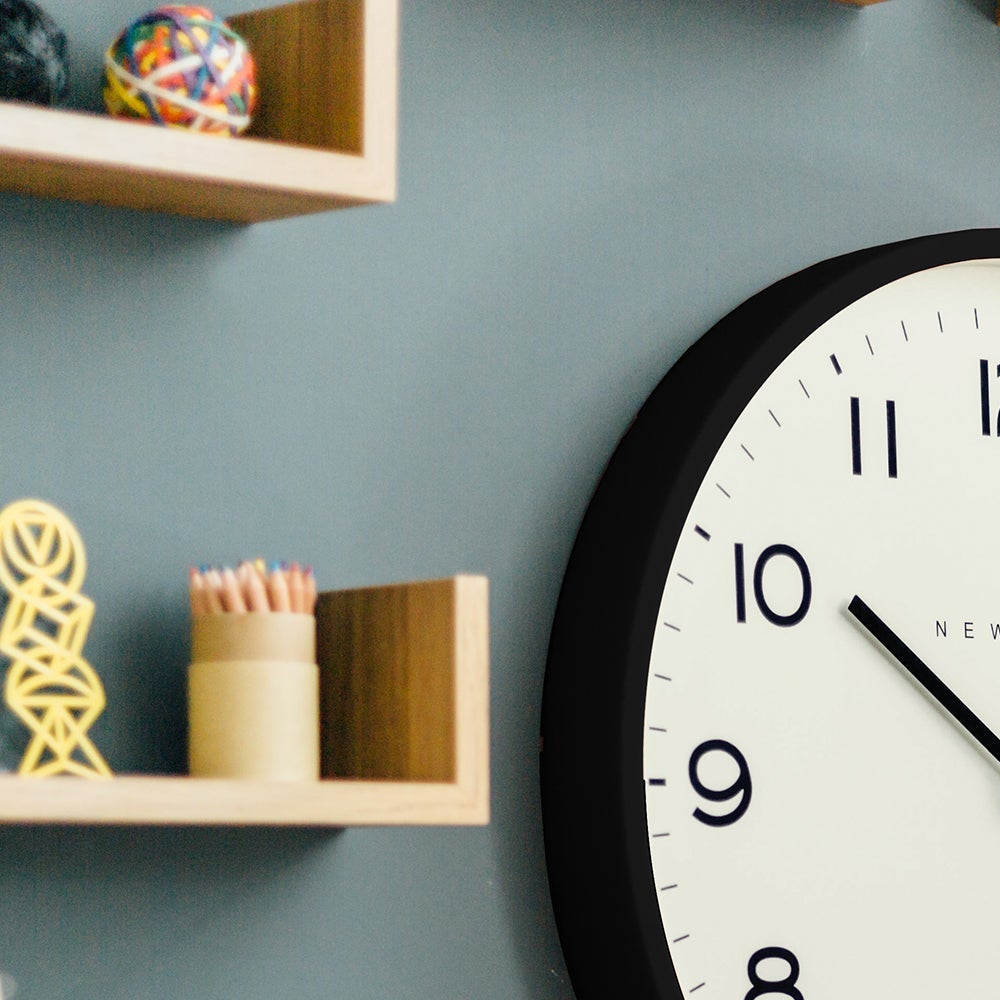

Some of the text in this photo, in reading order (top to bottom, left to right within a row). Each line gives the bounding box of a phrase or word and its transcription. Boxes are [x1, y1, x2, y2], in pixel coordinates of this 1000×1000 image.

[850, 396, 898, 479] 11
[734, 542, 812, 628] 10
[688, 739, 753, 828] 9
